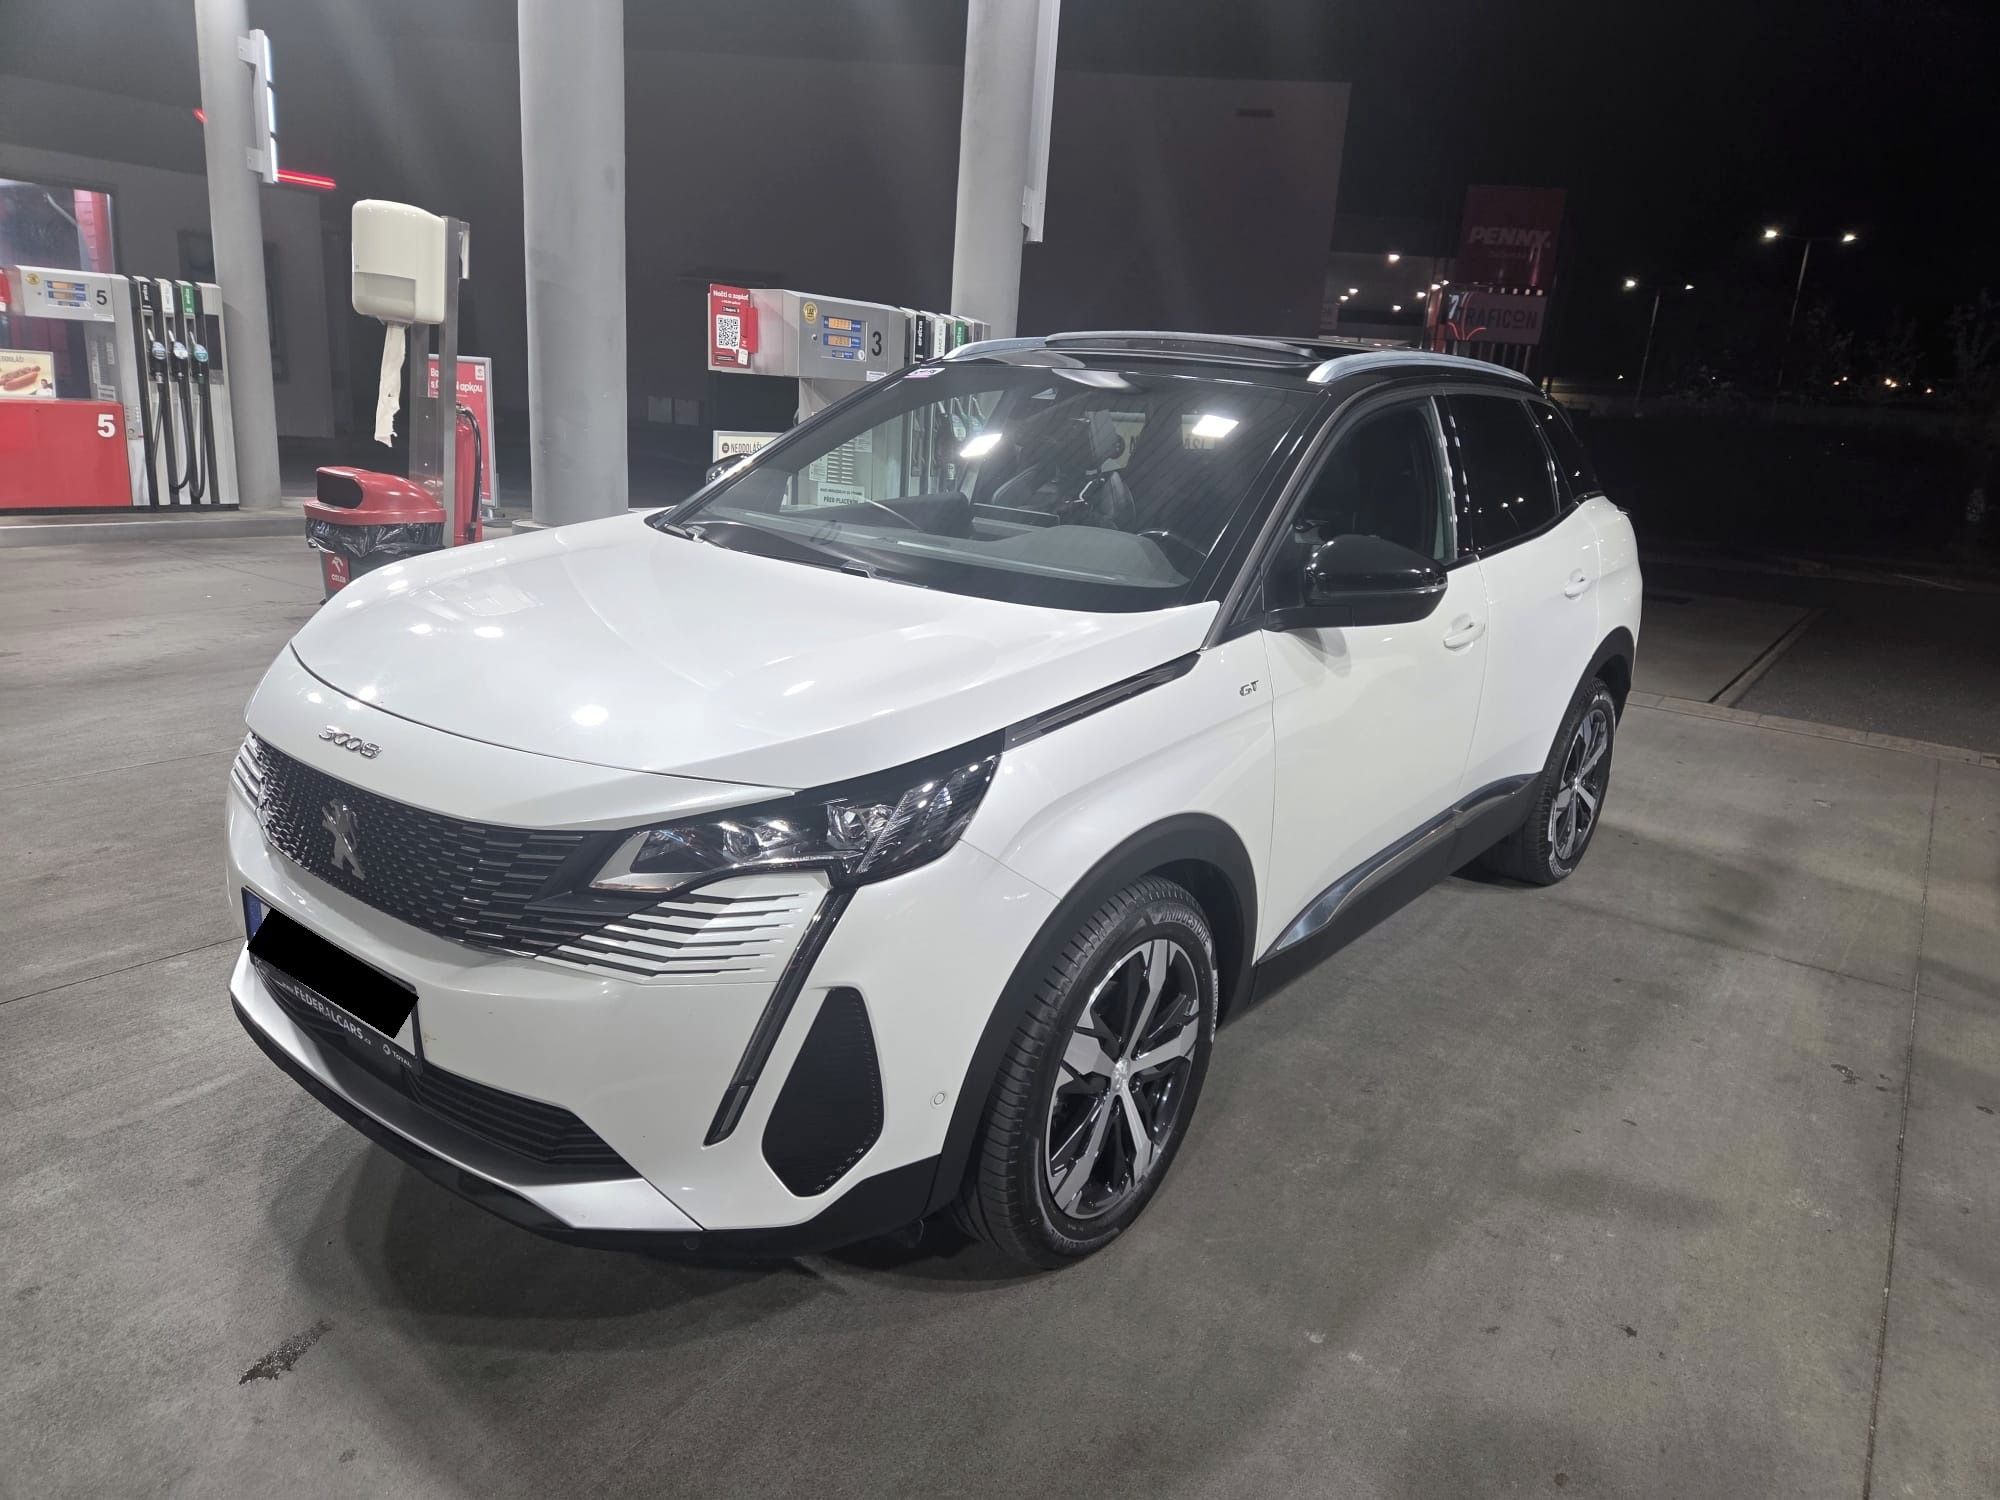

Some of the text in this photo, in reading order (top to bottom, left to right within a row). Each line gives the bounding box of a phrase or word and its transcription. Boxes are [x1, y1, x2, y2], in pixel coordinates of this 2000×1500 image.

[96, 290, 107, 305] 5
[871, 331, 882, 357] 3
[97, 413, 116, 438] 5
[1239, 679, 1259, 697] GT
[318, 724, 383, 759] 3008
